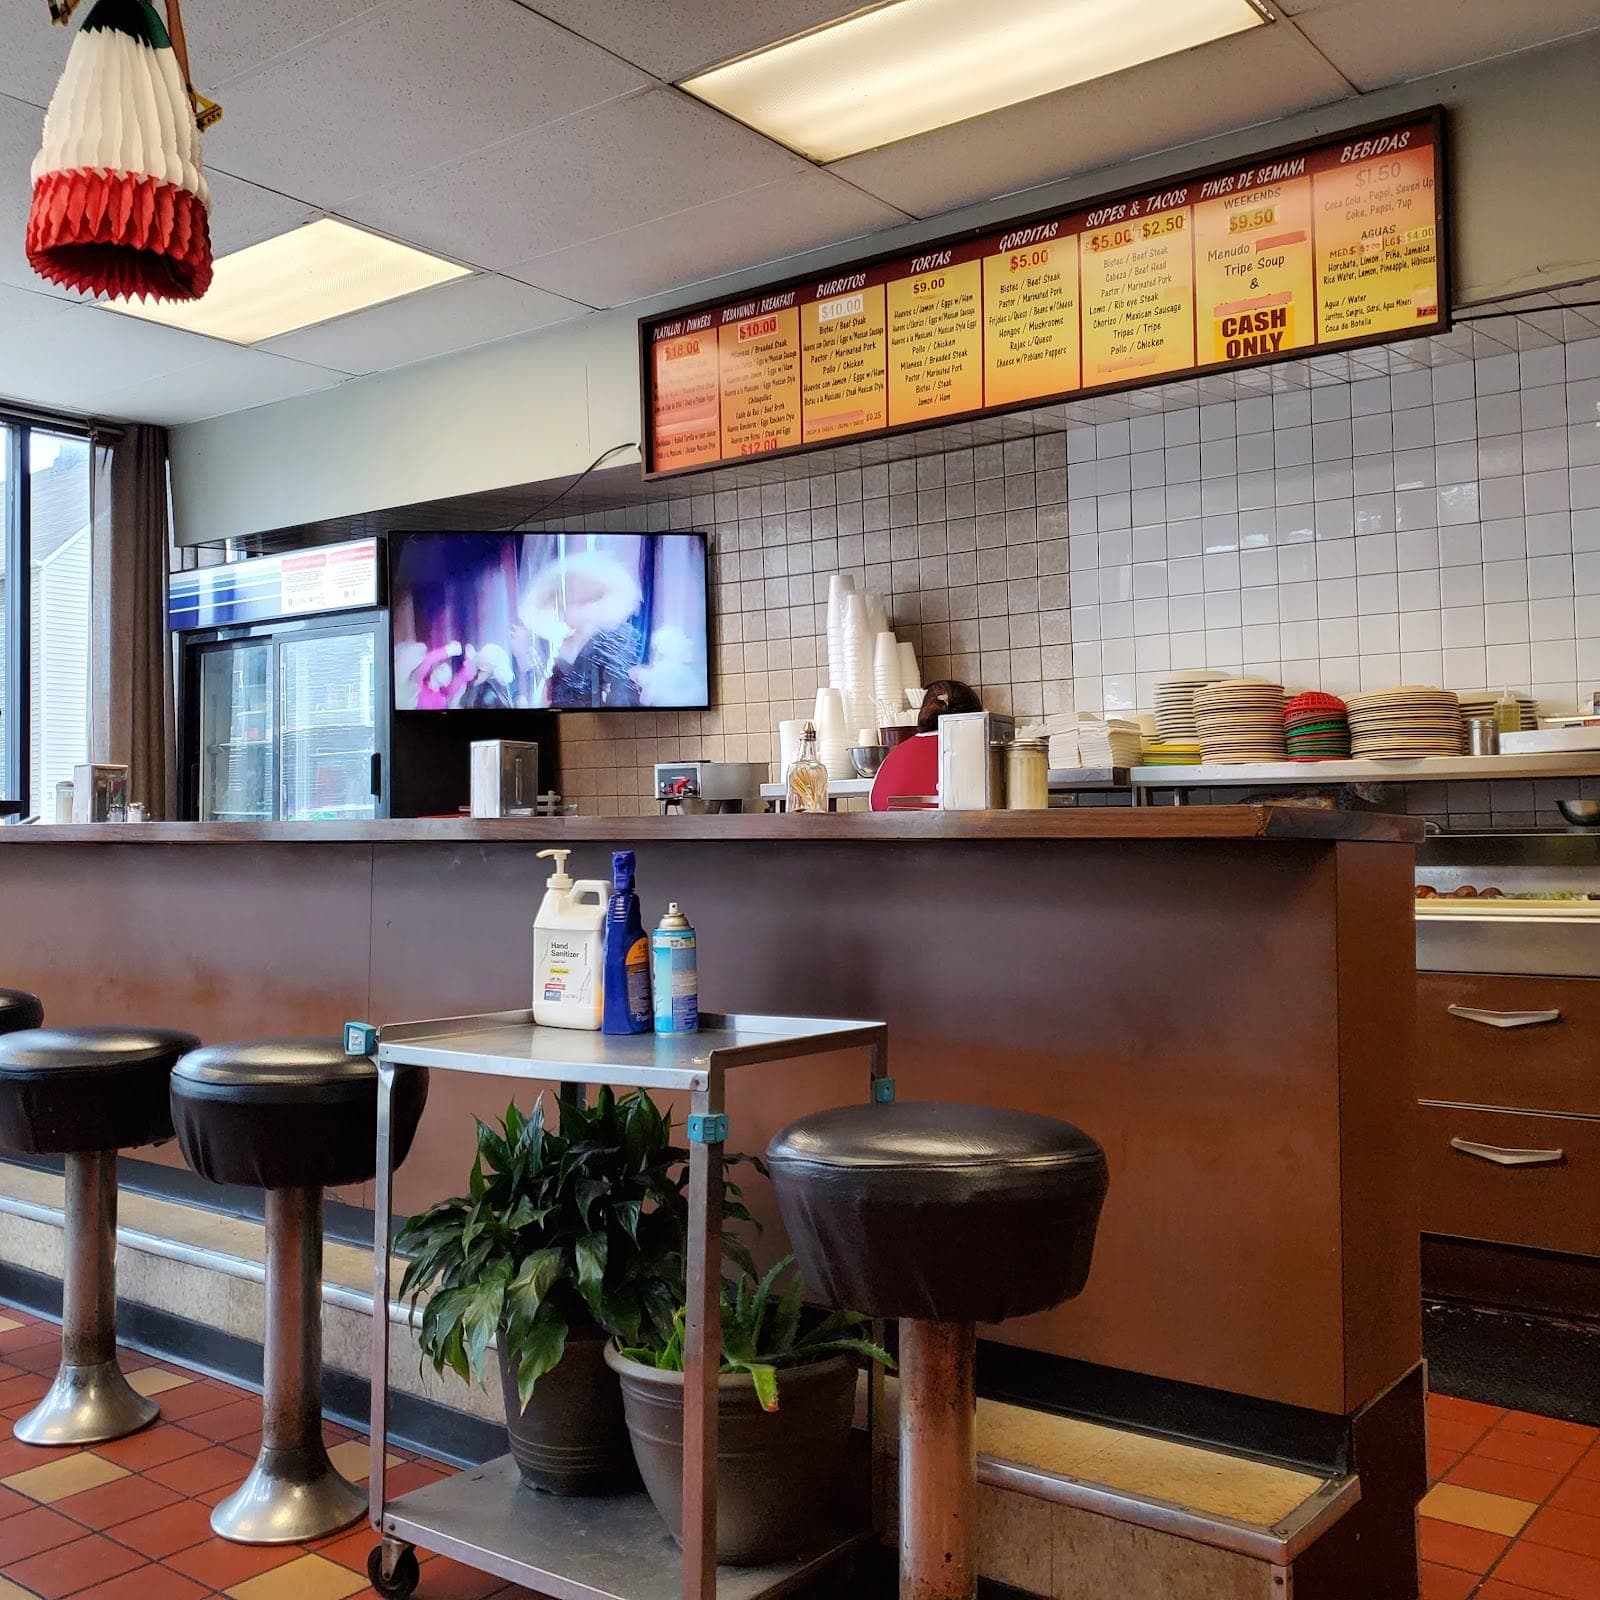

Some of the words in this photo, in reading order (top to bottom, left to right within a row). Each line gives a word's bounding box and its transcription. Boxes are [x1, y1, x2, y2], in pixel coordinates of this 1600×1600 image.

[1340, 131, 1410, 163] BEBIDAS
[1200, 177, 1234, 199] FINES
[1237, 170, 1255, 189] DE
[1257, 158, 1305, 184] SEMANA
[1355, 161, 1401, 187] $1.50
[1086, 204, 1126, 227] SOPES
[1130, 201, 1140, 216] &
[1146, 189, 1187, 212] TACOS
[1224, 187, 1281, 209] WEEKENDS
[1142, 215, 1183, 239] $2.50
[1229, 209, 1273, 232] $9.50
[999, 222, 1058, 253] GORDITAS
[1361, 224, 1396, 240] AGUAS
[1010, 249, 1048, 271] $5.00
[1104, 257, 1123, 268] Bistec
[1132, 250, 1148, 262] Beef
[1149, 246, 1168, 258] Steak
[1208, 243, 1250, 262] Menudo
[1404, 244, 1430, 256] Jamaica
[910, 250, 952, 273] TORTAS
[1105, 271, 1127, 282] Cabeza
[1135, 264, 1149, 275] Beef
[1151, 260, 1167, 272] Head
[1224, 262, 1253, 276] Tripe
[1257, 255, 1285, 270] Soup
[816, 273, 866, 298] BURRITOS
[913, 278, 945, 294] $9.00
[1000, 283, 1019, 294] Bistec
[1027, 276, 1041, 287] Beef
[1043, 272, 1061, 283] Steak
[1127, 277, 1156, 292] Marinated
[1249, 277, 1259, 289] &
[761, 292, 795, 312] BREAKFAST
[822, 299, 860, 319] $10.00
[1089, 306, 1106, 315] Lomo
[1114, 299, 1124, 310] Rib
[1140, 292, 1159, 304] Steak
[1029, 317, 1064, 331] Mushrooms
[1093, 317, 1117, 329] Chorizo
[1125, 309, 1152, 322] Mexican
[1154, 304, 1182, 316] Sausage
[1222, 307, 1286, 337] CASH
[740, 320, 776, 339] $10.00
[1143, 322, 1161, 334] Tripe
[1110, 344, 1127, 355] Pollo
[1136, 338, 1164, 350] Chicken
[1226, 331, 1283, 359] ONLY
[551, 942, 568, 950] Hand
[551, 950, 580, 958] Sanitizer
